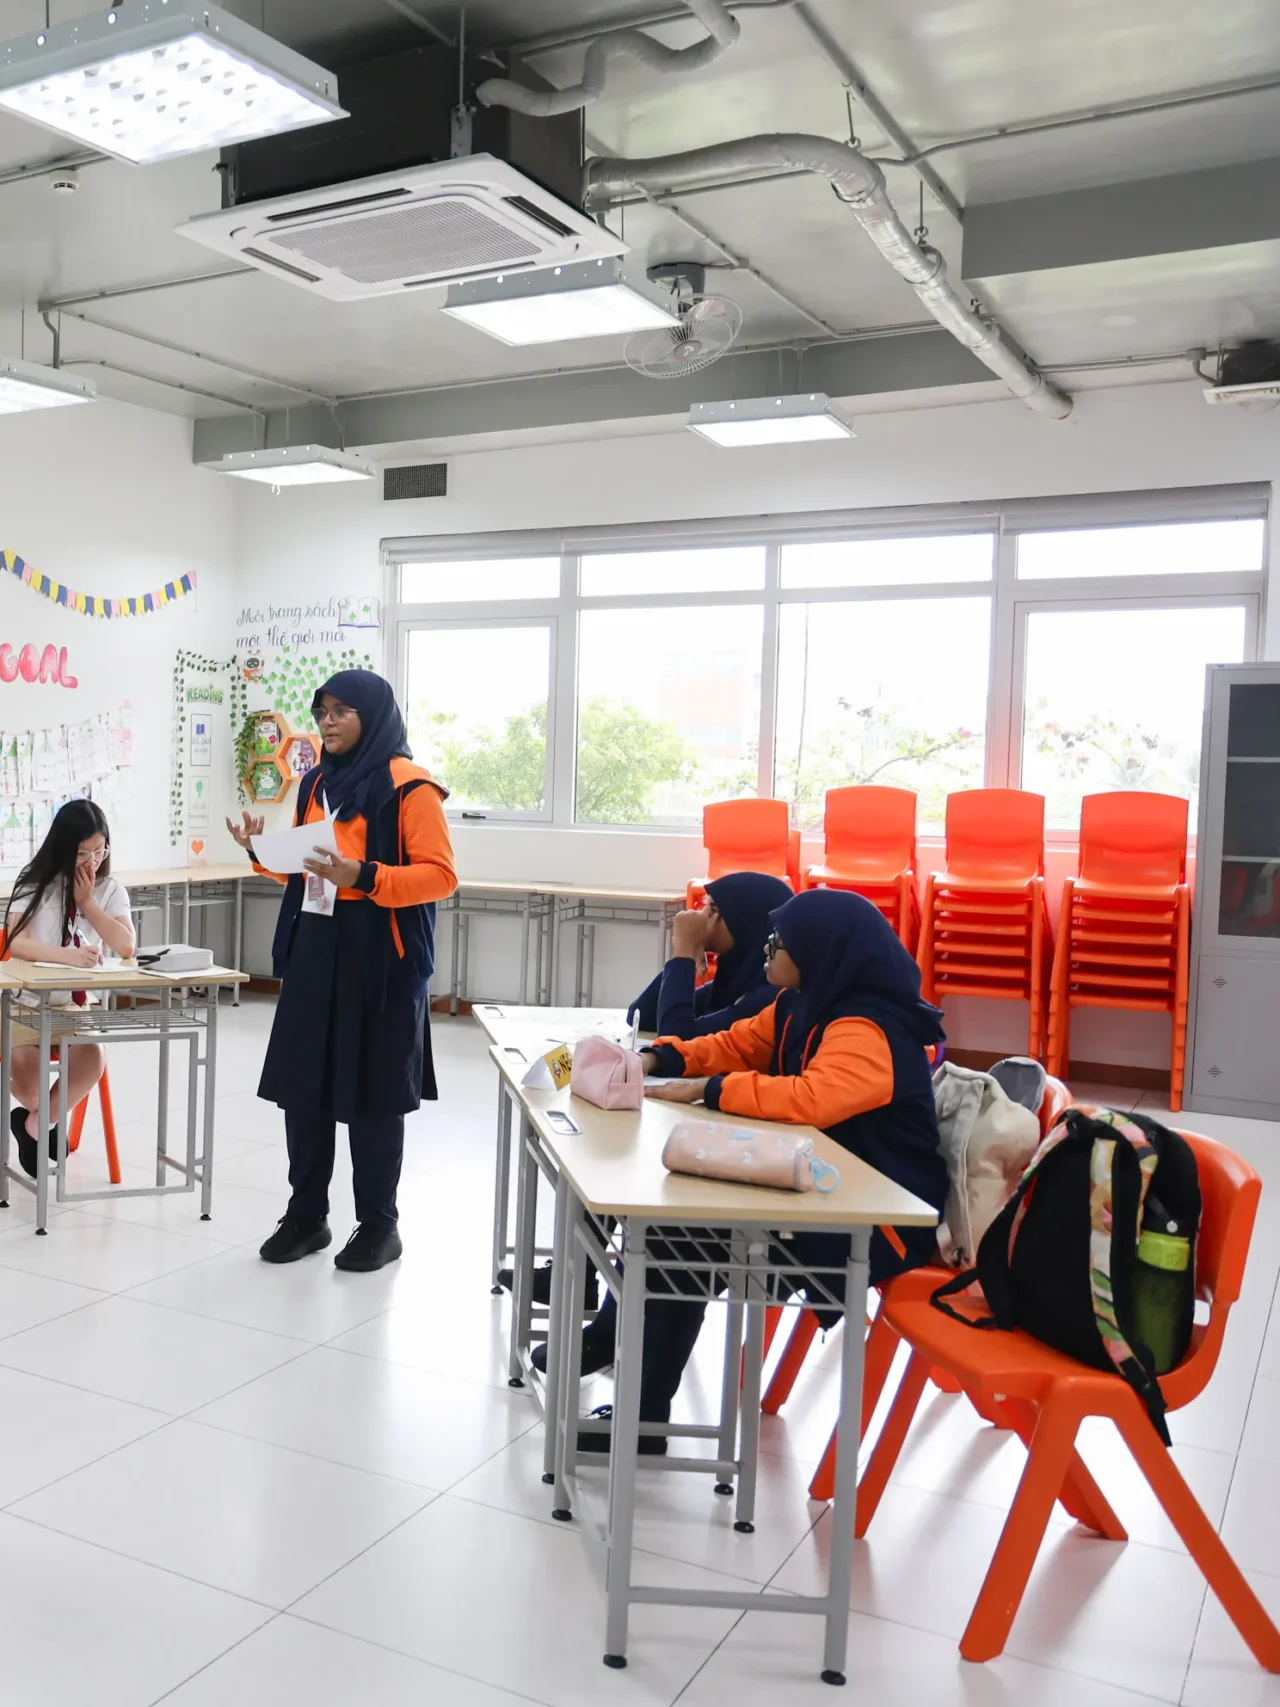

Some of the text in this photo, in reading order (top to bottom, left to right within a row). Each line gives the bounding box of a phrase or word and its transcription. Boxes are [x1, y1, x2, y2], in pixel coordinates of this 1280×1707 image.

[268, 604, 301, 628] trang
[304, 597, 338, 619] sách
[187, 686, 224, 704] READING
